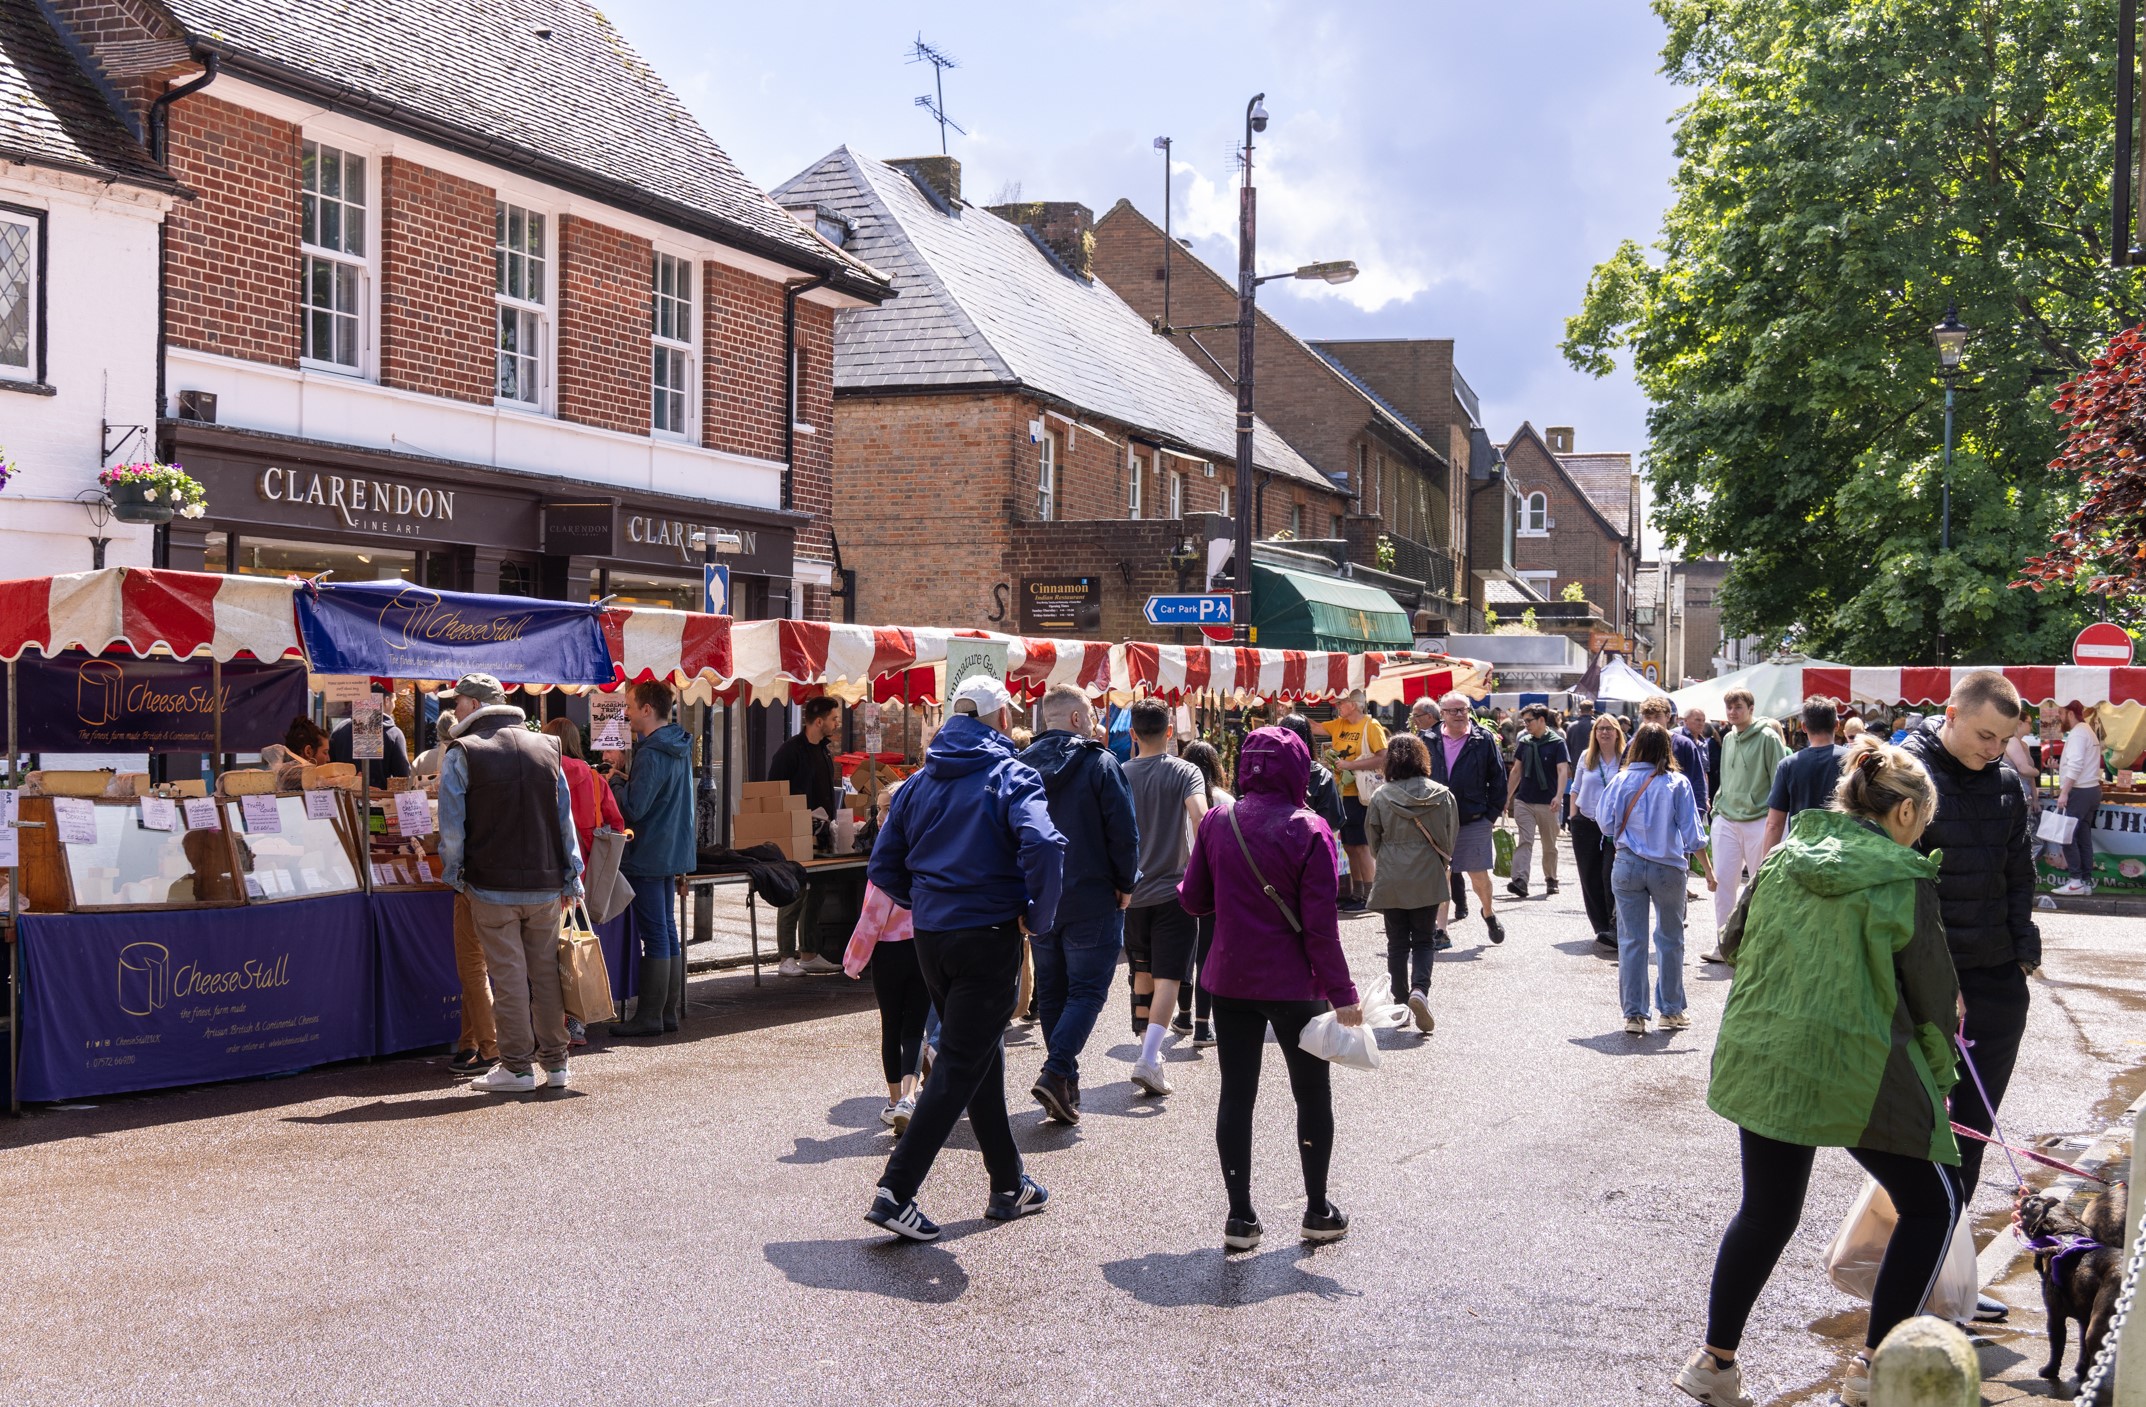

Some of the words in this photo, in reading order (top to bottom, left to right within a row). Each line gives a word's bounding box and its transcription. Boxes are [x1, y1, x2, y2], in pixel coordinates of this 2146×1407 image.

[263, 467, 455, 526] CLARENDON
[354, 519, 387, 532] FINE
[396, 524, 421, 535] ART
[550, 525, 608, 536] CLARENDON
[631, 516, 757, 562] CLAREON
[1030, 583, 1089, 594] Cinnamon
[1160, 604, 1177, 614] Car
[1178, 604, 1198, 614] Park
[1199, 599, 1215, 621] P
[426, 609, 534, 642] CheeseStall
[388, 653, 398, 665] The
[445, 657, 464, 669] British
[472, 660, 504, 671] Continental
[504, 661, 526, 671] Cheeses
[79, 729, 90, 741] The
[88, 729, 109, 744] finest
[107, 730, 125, 744] farm
[142, 730, 162, 741] British
[169, 730, 201, 741] Continental
[174, 953, 290, 997] CheeseStall
[180, 1007, 190, 1019] the
[187, 1006, 212, 1023] finest
[210, 1004, 229, 1021] farm
[230, 1002, 247, 1013] made
[203, 1027, 229, 1039] Artisan
[230, 1022, 254, 1035] British
[254, 1021, 261, 1032] &
[261, 1016, 298, 1032] Continental
[298, 1014, 320, 1026] Cheeses
